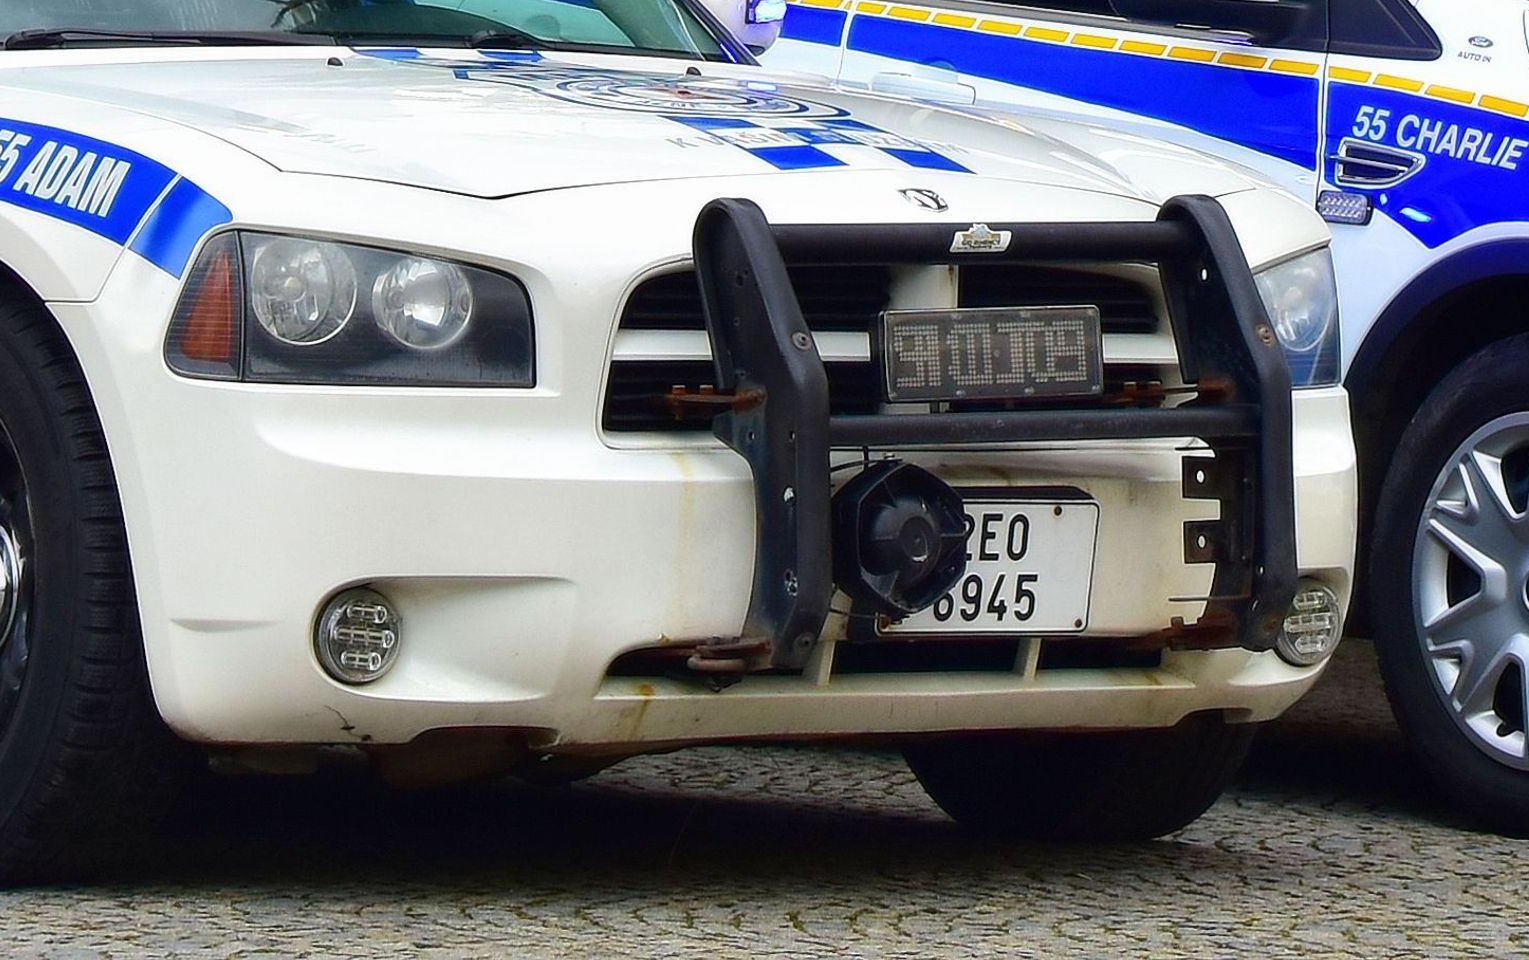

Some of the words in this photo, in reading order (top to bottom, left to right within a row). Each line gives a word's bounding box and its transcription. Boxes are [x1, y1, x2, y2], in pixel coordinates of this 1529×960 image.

[1457, 51, 1481, 61] AUTO
[1352, 105, 1390, 140] 55
[1396, 114, 1529, 171] CHARLIE
[12, 140, 131, 218] ADAM
